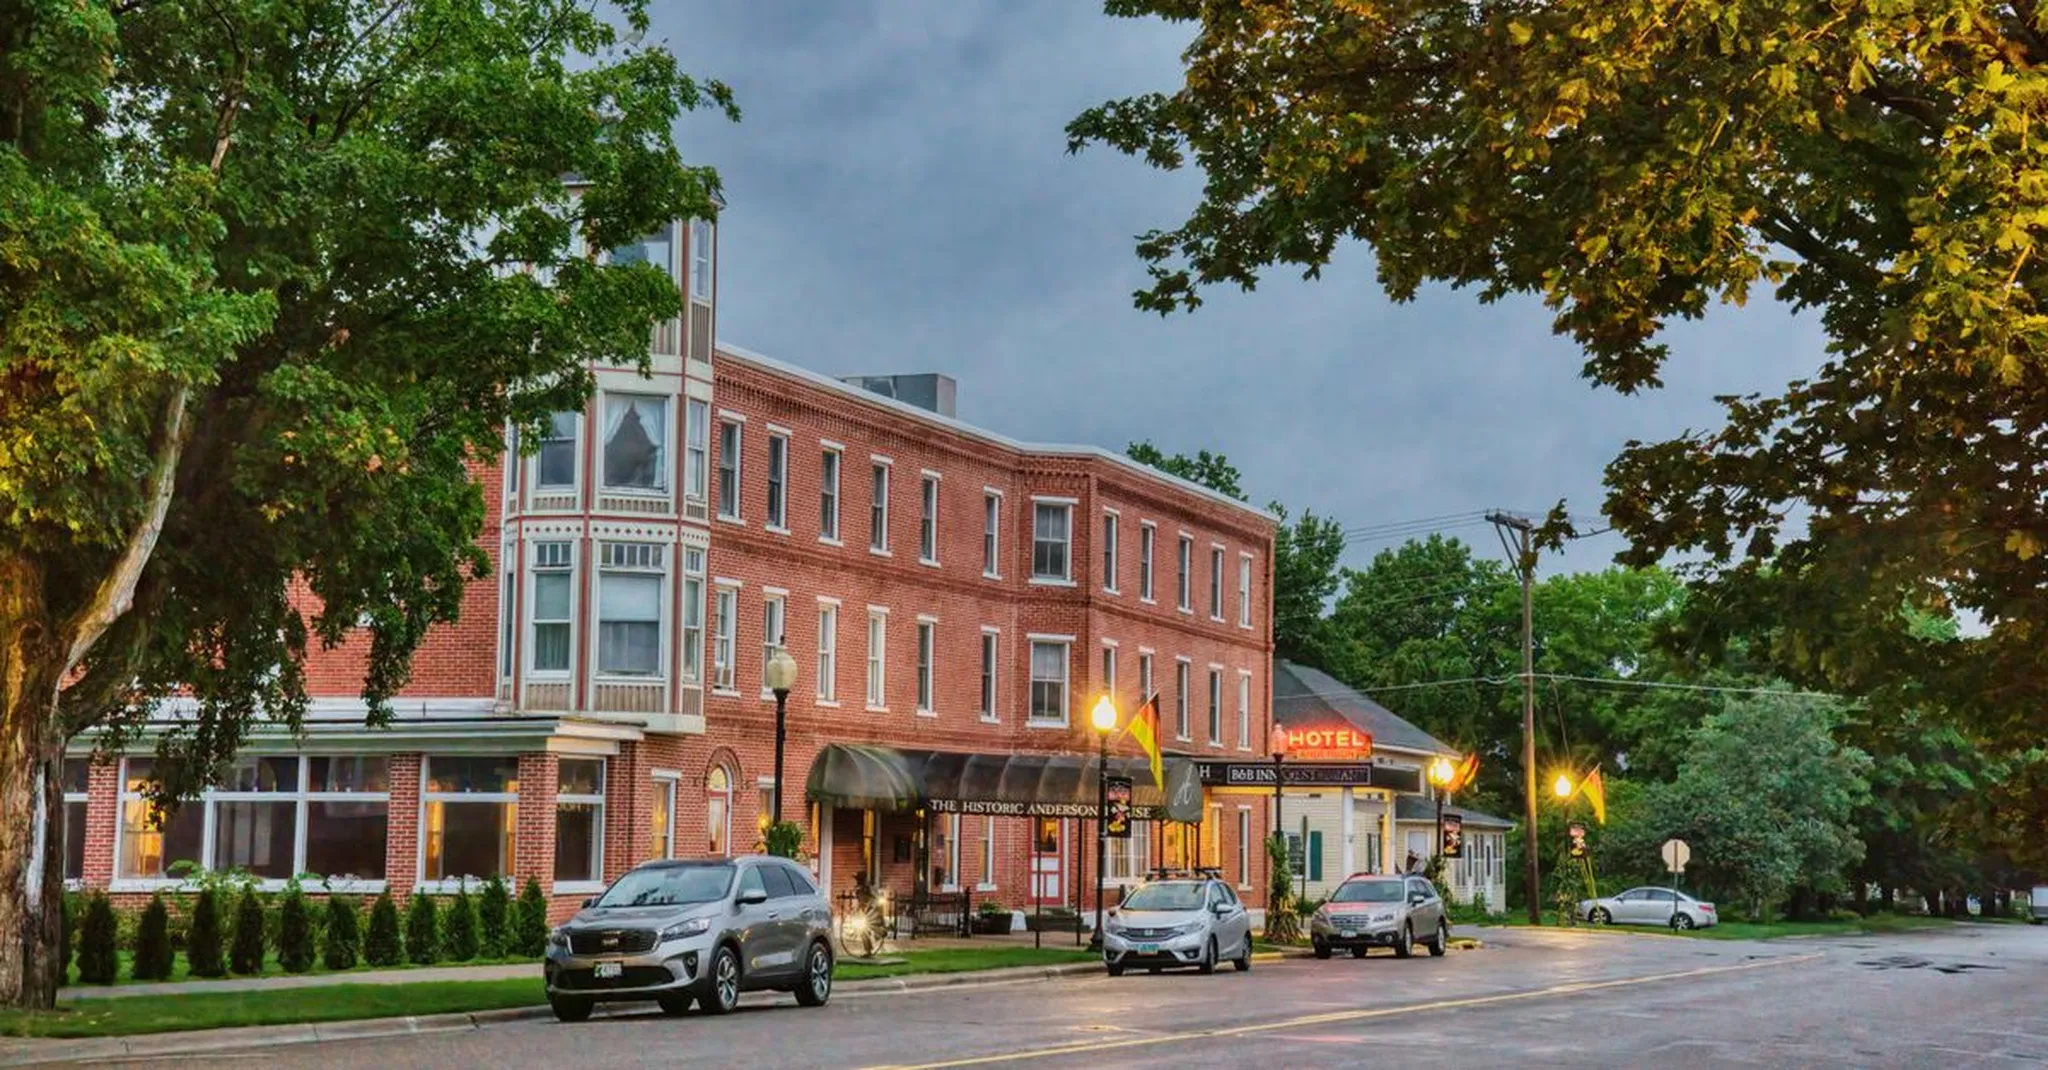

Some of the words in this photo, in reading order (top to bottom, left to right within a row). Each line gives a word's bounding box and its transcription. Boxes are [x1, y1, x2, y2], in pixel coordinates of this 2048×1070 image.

[1288, 730, 1365, 747] HOTEL
[1231, 769, 1255, 781] B&B
[931, 799, 957, 812] THE
[962, 801, 1025, 815] HISTORIC
[1026, 802, 1099, 816] ANDERSON
